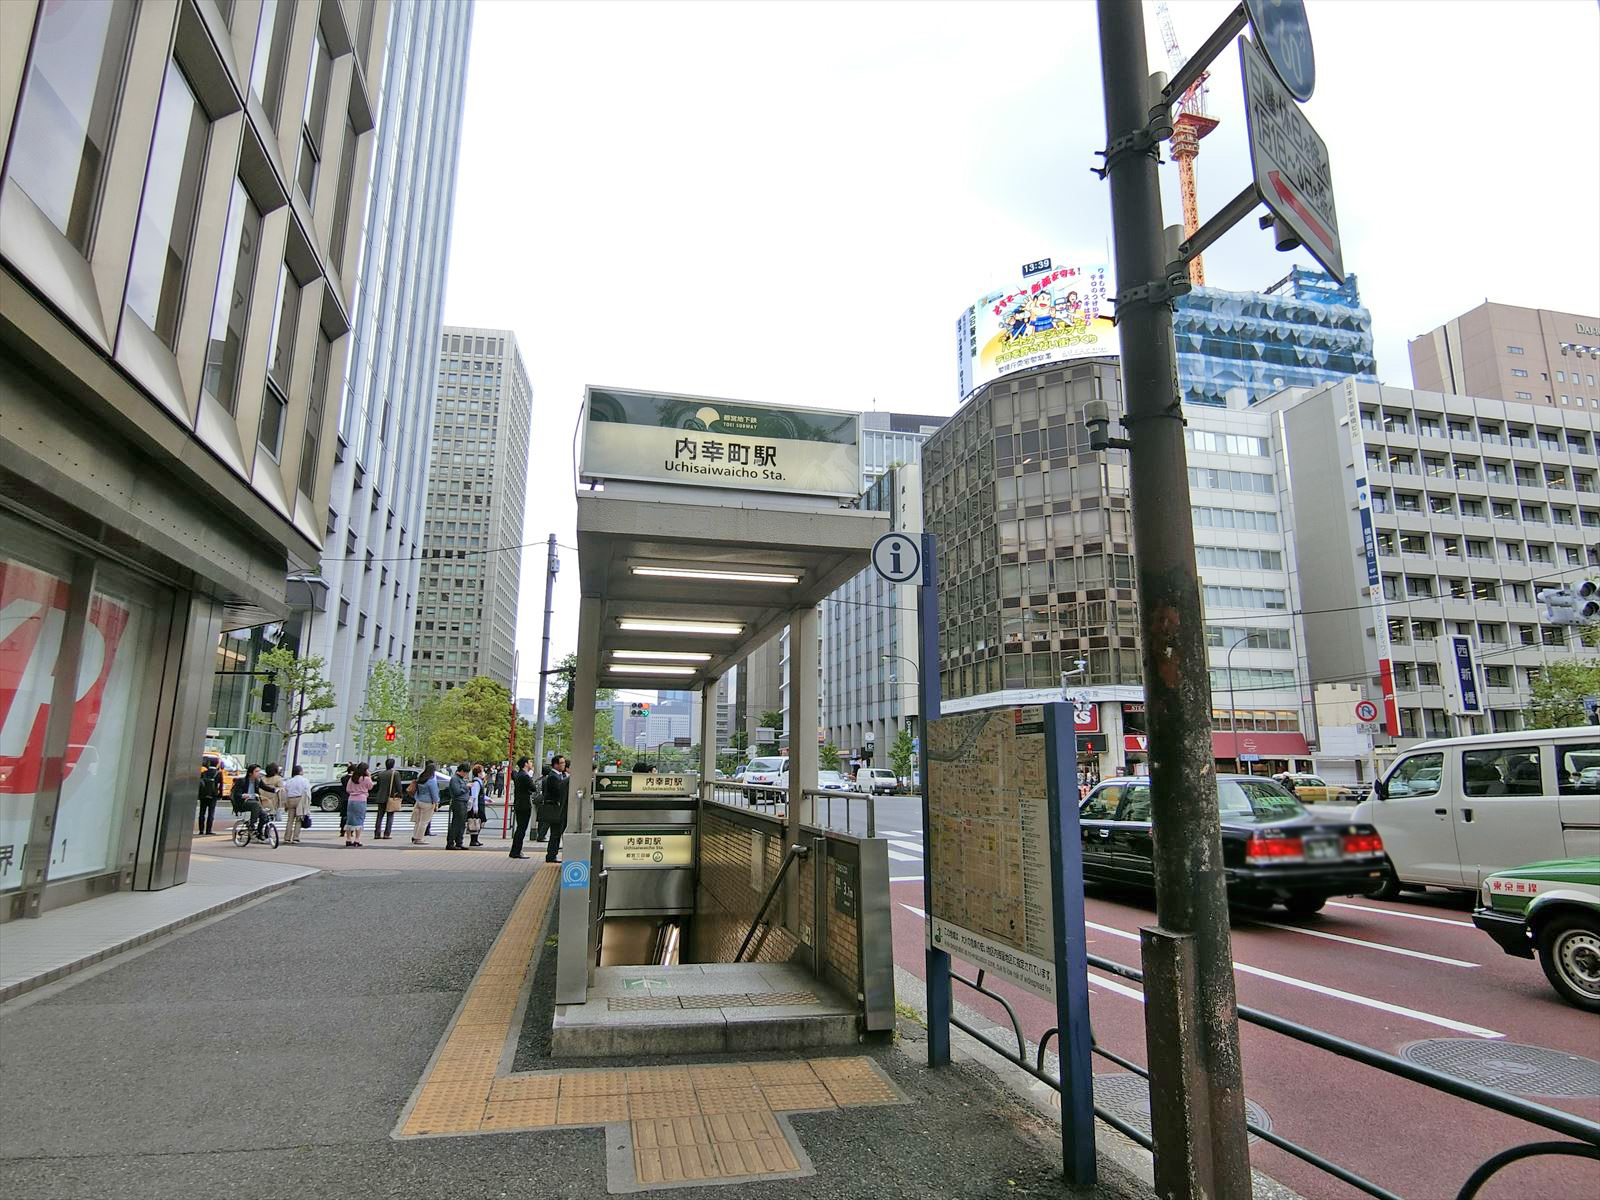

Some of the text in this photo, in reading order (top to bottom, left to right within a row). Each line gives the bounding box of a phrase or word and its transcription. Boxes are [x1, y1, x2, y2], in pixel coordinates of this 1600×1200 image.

[1024, 259, 1050, 273] 13:39
[675, 437, 777, 467] 内幸町駅
[664, 460, 787, 481] Uchisaiwaicho Sta.
[1456, 644, 1477, 705] 西新橋
[645, 777, 683, 787] 内幸町駅
[627, 837, 662, 846] 内幸町駅
[1493, 880, 1537, 893] 東京無線
